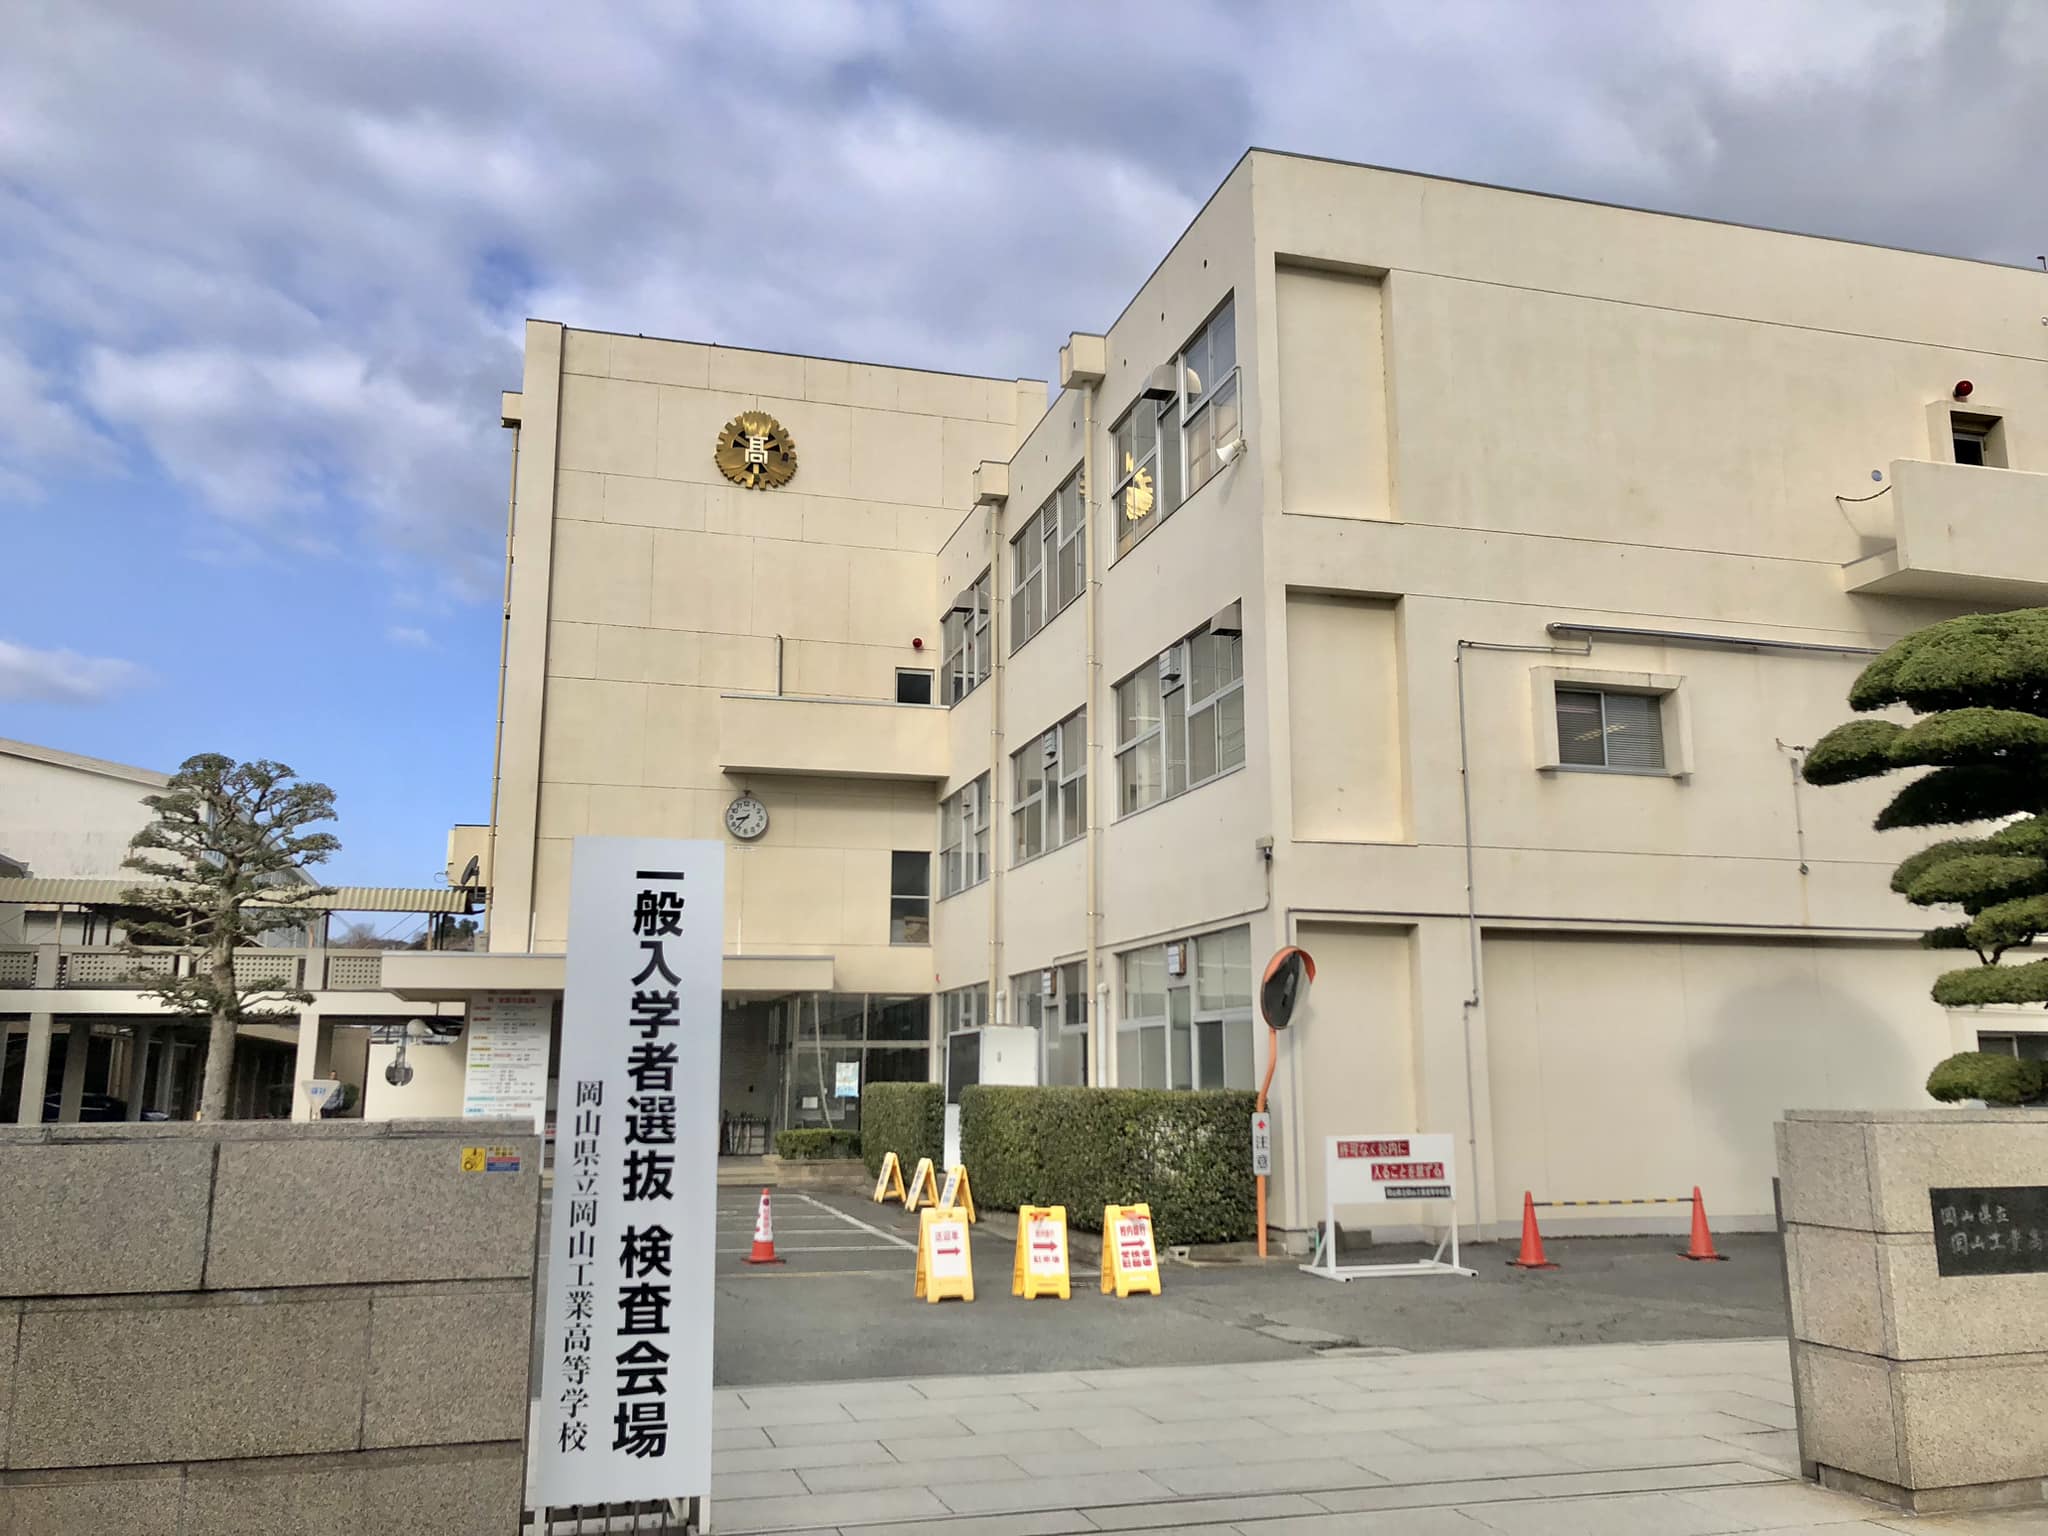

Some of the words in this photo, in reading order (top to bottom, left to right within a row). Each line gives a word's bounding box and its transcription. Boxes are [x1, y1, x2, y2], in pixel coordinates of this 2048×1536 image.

[622, 870, 685, 1202] 一般入学者選抜
[558, 1080, 603, 1453] 岡山県立岡山工業高等学校
[612, 1225, 674, 1459] 検査会場
